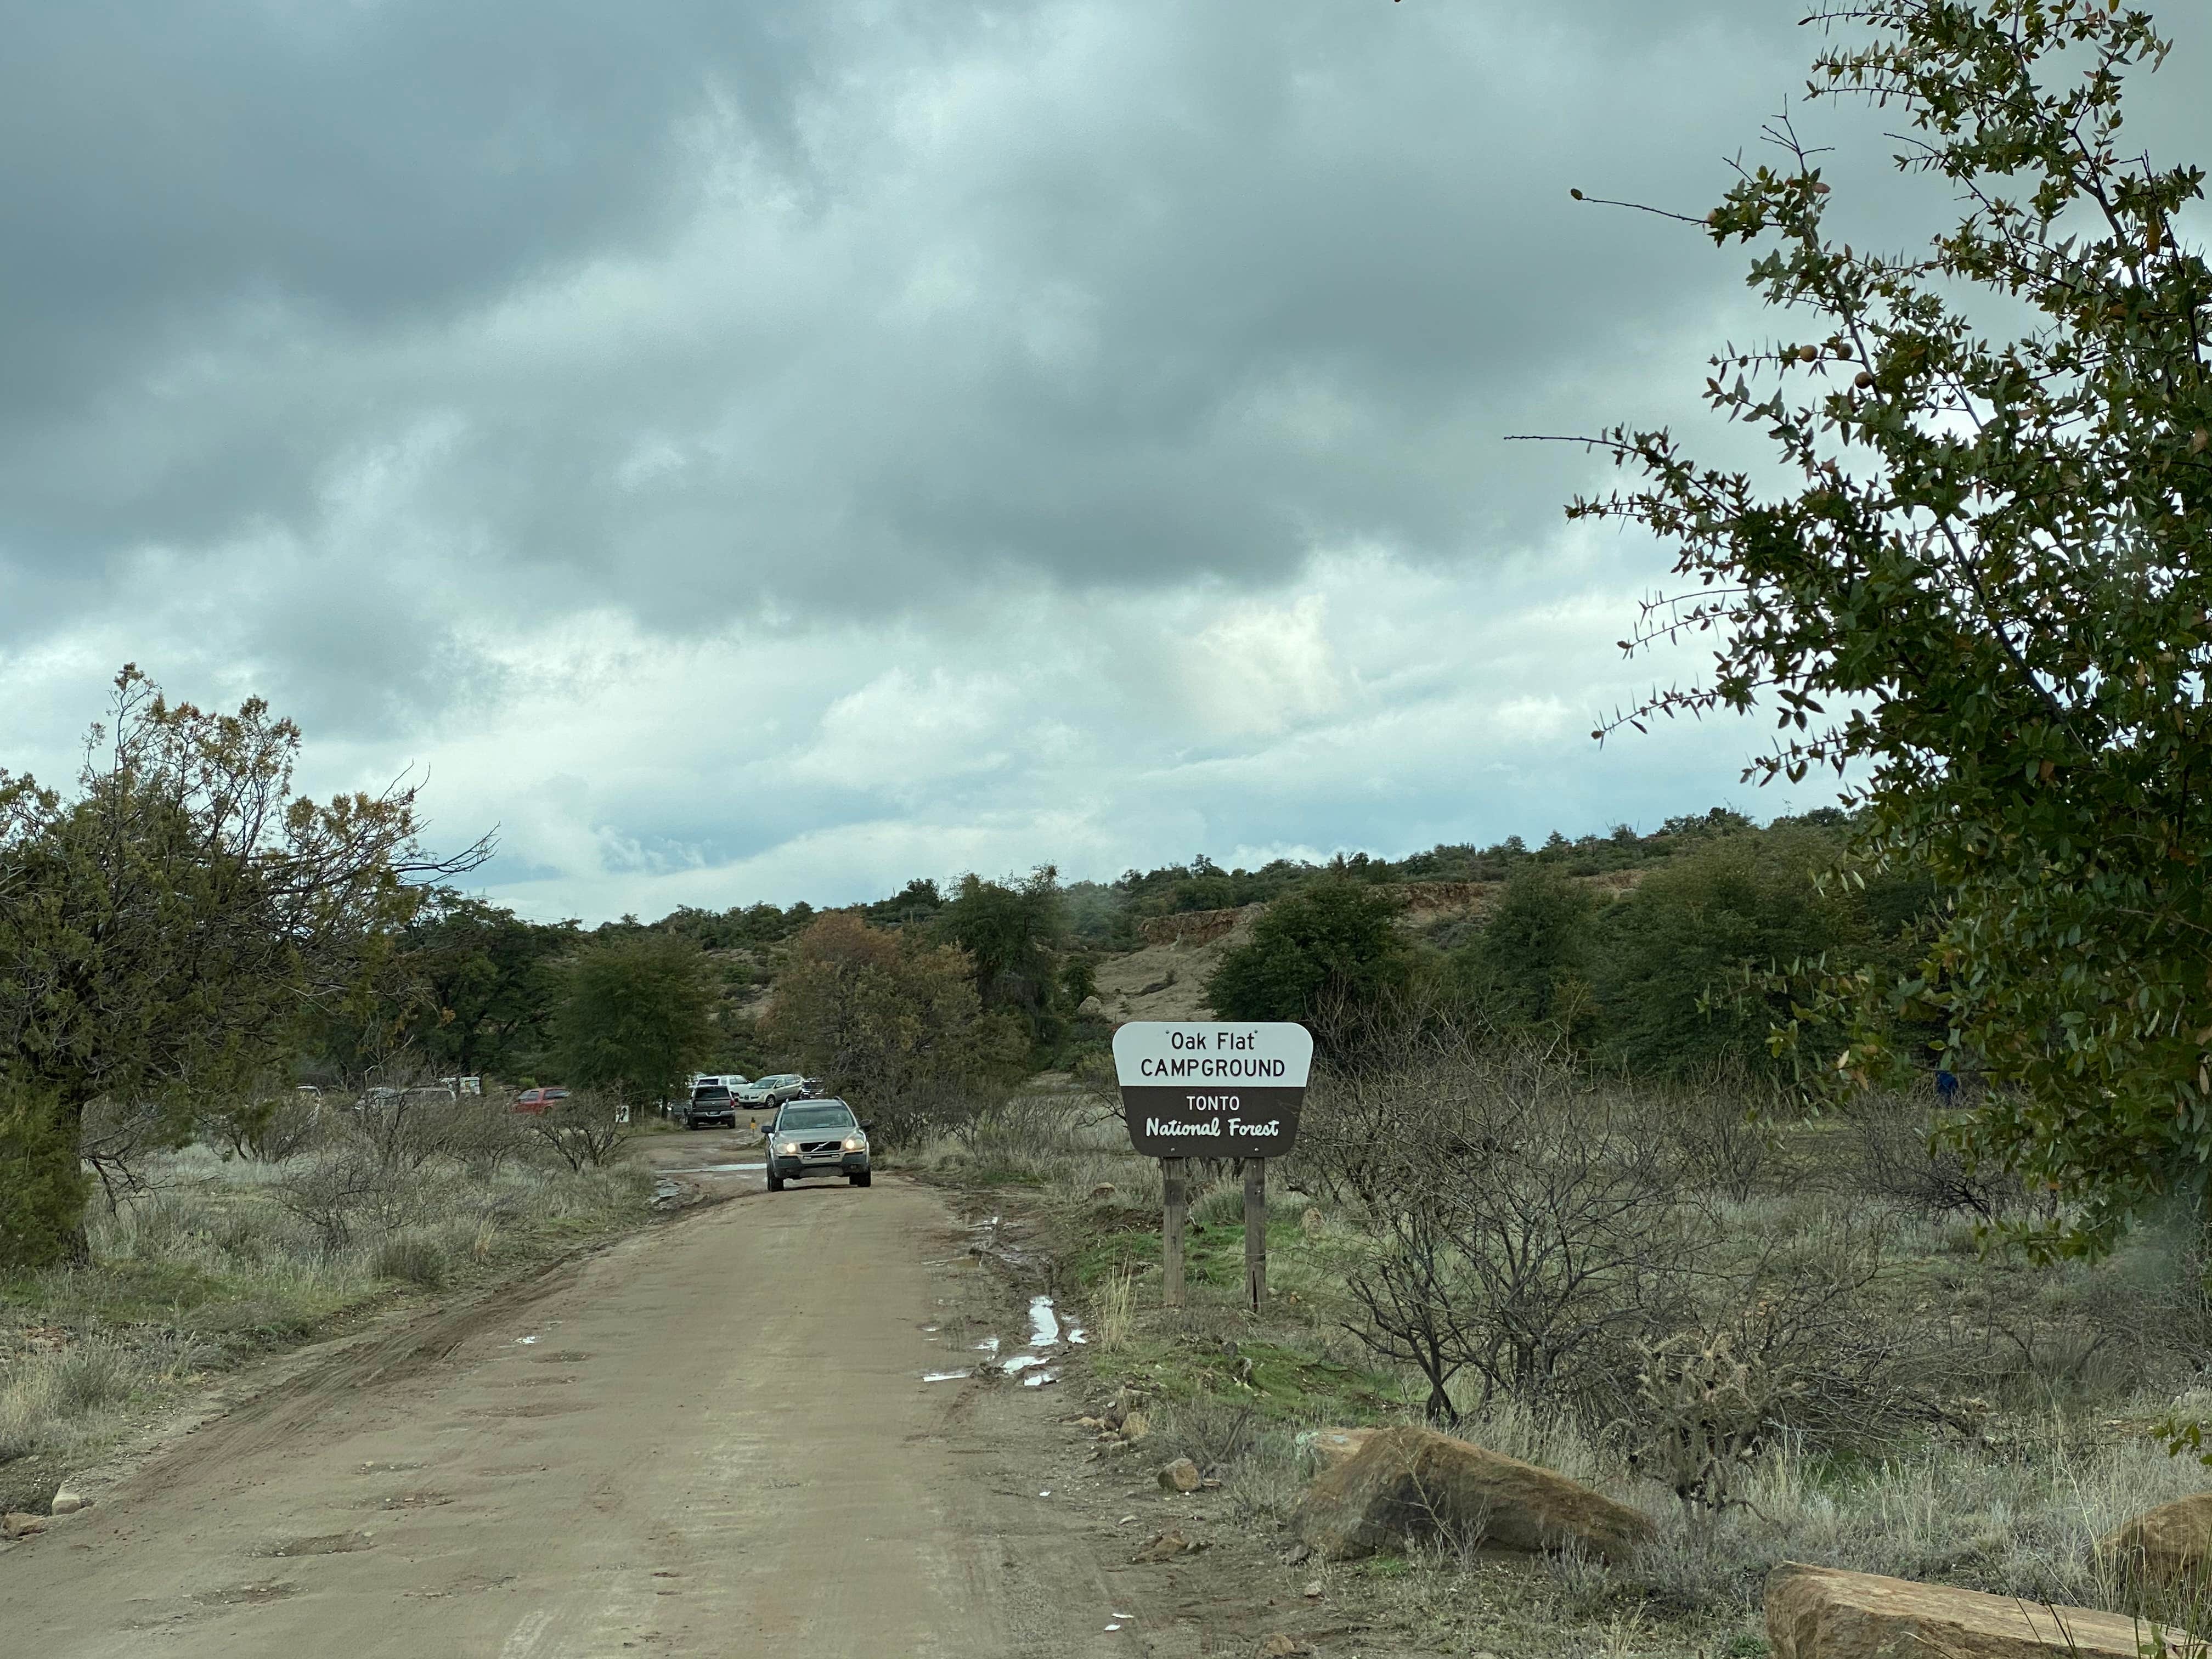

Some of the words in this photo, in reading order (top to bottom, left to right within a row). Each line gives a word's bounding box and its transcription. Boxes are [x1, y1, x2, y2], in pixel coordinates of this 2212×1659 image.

[1171, 1031, 1207, 1050] Oak
[1217, 1032, 1255, 1050] Flat
[1141, 1058, 1285, 1077] CAMPGROUND
[1186, 1096, 1240, 1111] TONTO
[1146, 1118, 1221, 1137] National
[1227, 1118, 1280, 1137] Forest
